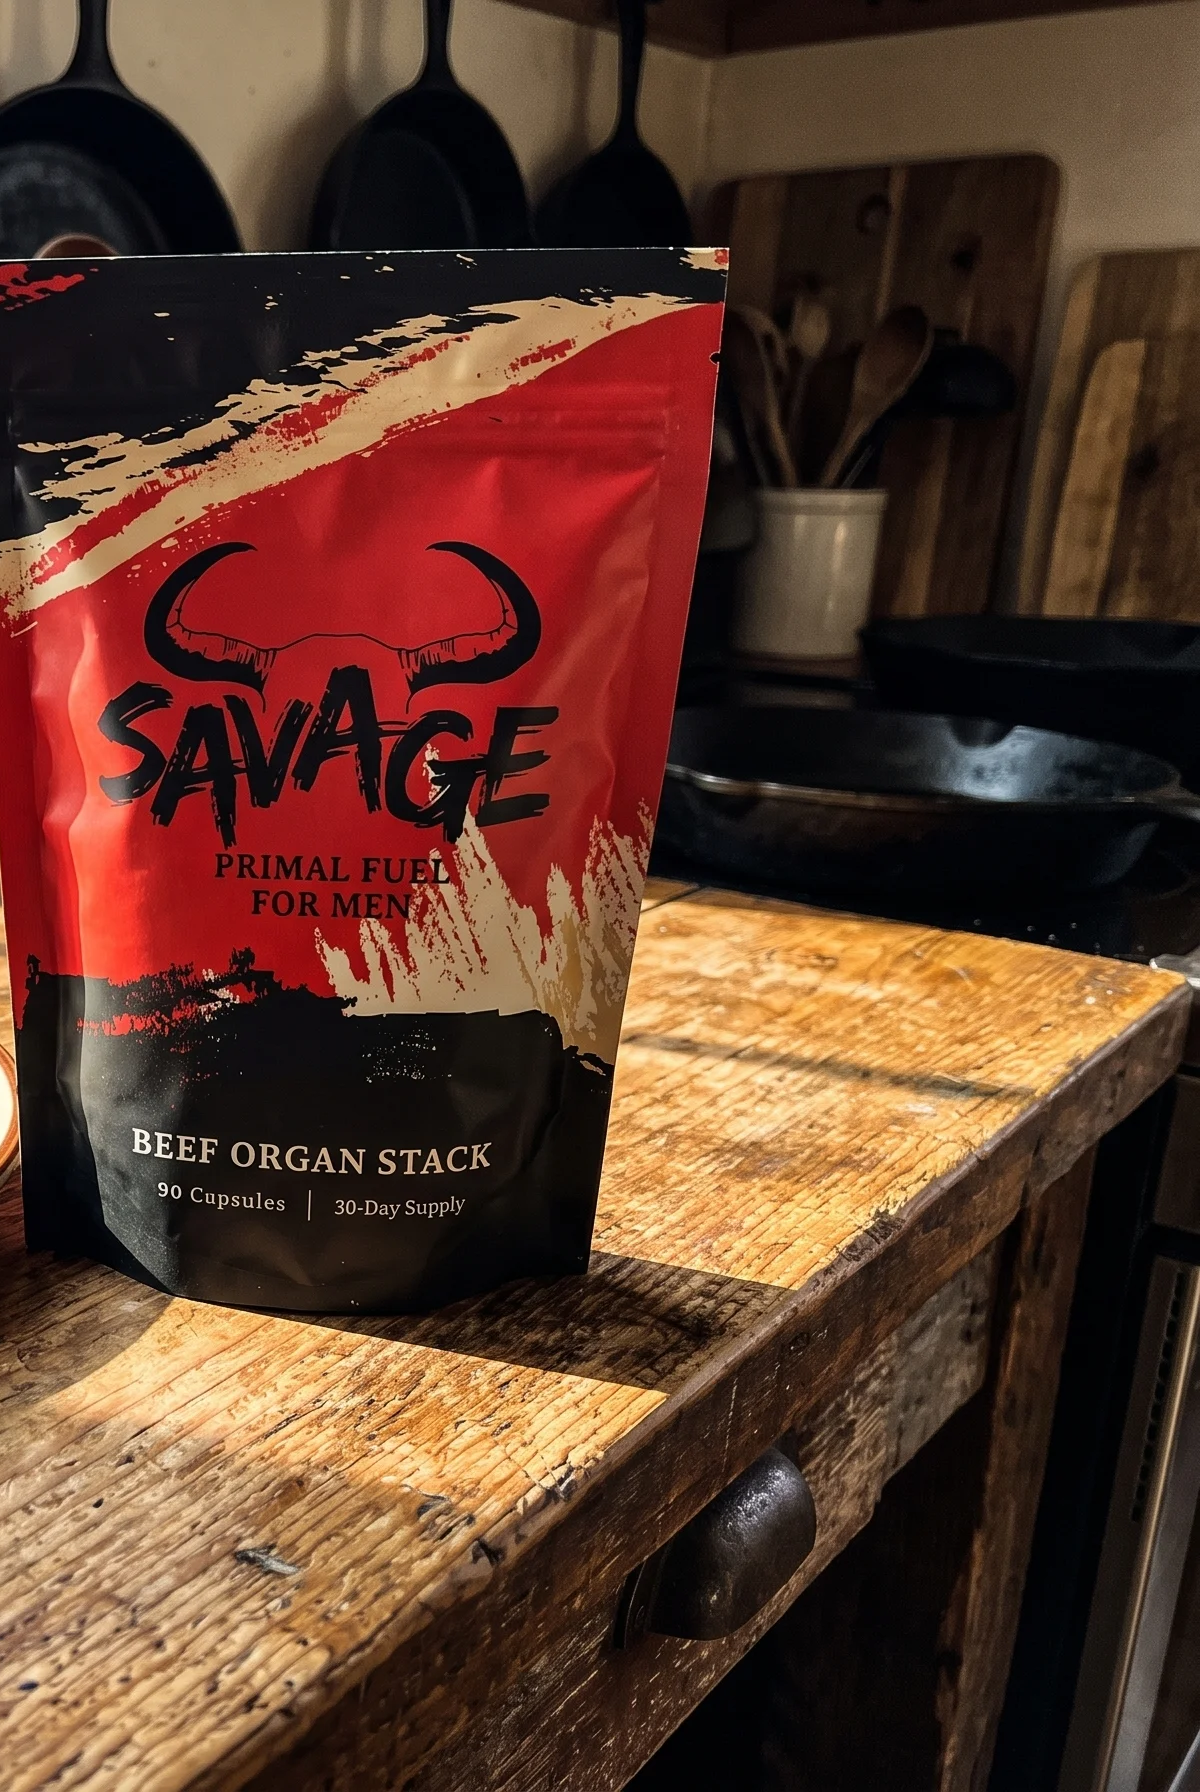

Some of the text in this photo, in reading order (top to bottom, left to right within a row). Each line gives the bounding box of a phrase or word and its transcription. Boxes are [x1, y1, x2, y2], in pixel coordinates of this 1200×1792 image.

[97, 664, 560, 850] SAVAGE
[214, 853, 451, 885] PRIMAL FUEL
[251, 889, 412, 919] FOR MEN
[131, 1127, 493, 1175] BEEF ORGAN STACK
[157, 1181, 182, 1200] 90
[334, 1195, 466, 1220] 30-Day Supply
